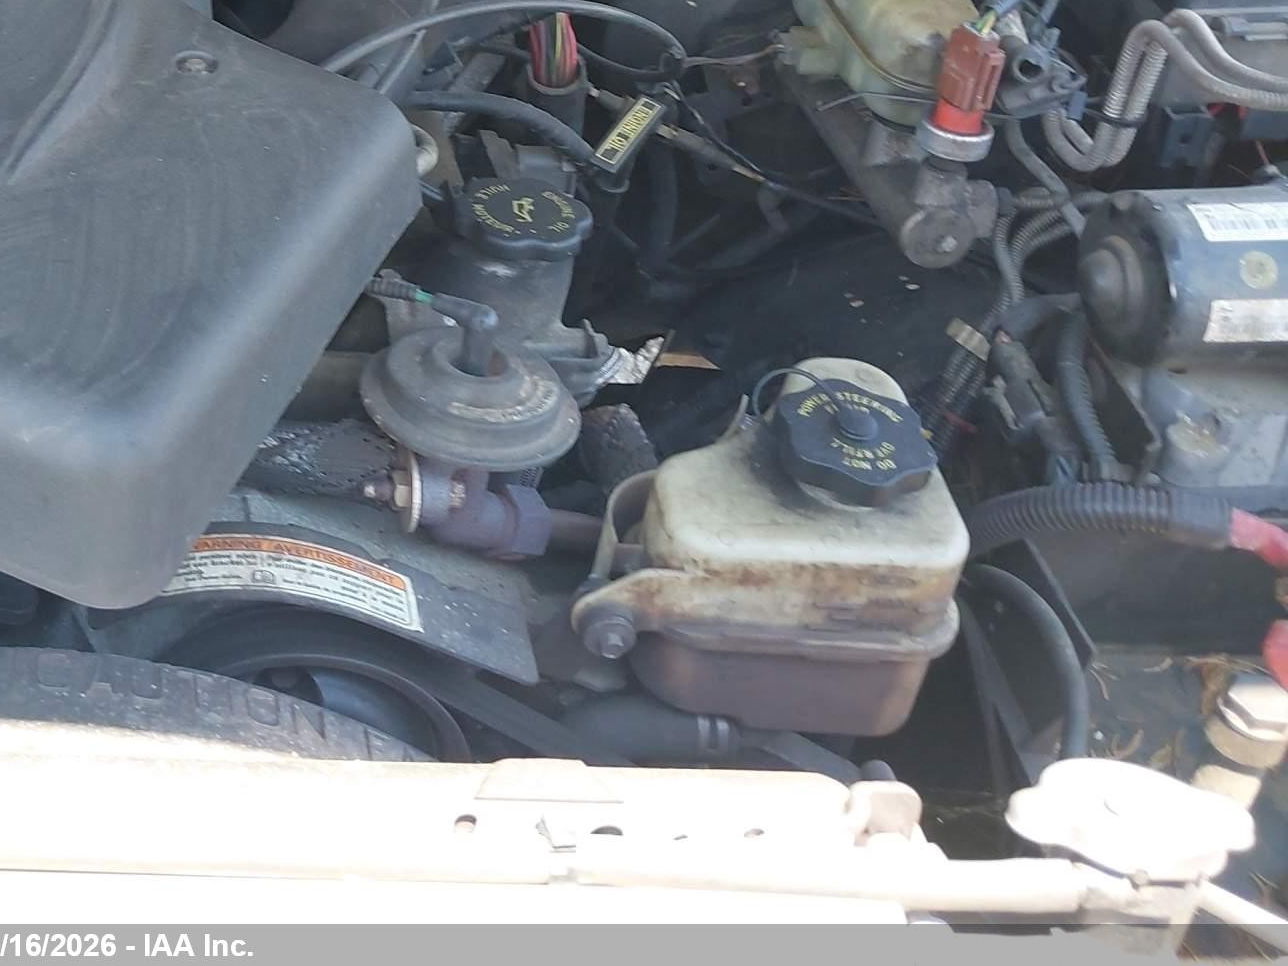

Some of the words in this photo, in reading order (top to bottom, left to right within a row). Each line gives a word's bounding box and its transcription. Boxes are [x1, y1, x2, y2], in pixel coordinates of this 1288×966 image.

[620, 105, 652, 138] ENGINE
[796, 393, 831, 417] POWER
[834, 391, 903, 424] STEERING
